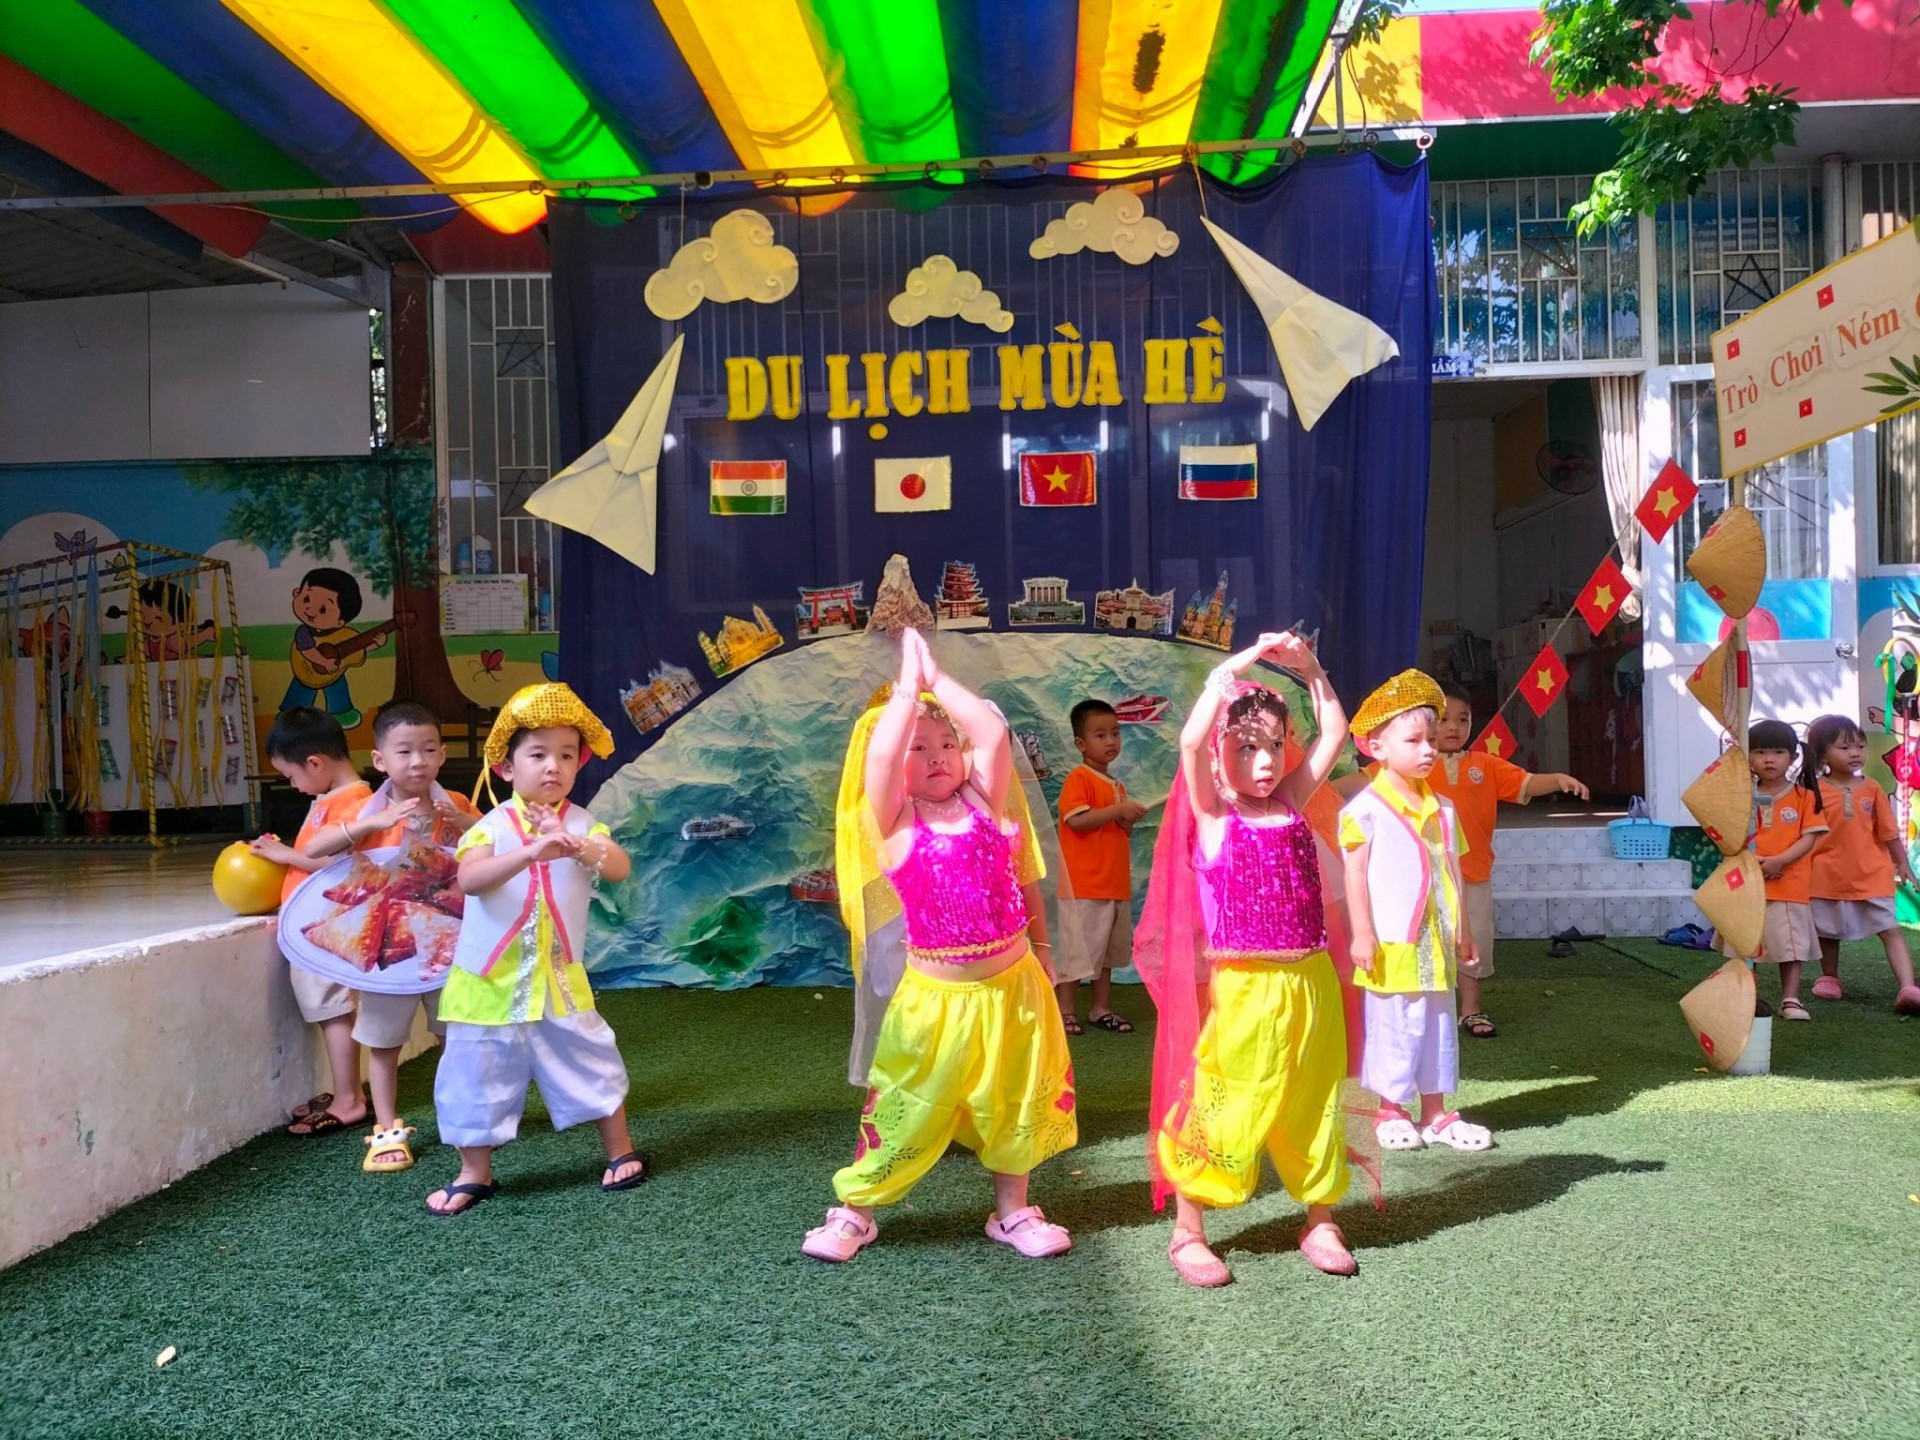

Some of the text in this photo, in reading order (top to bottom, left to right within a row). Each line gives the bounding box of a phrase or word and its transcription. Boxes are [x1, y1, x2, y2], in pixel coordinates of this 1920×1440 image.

[725, 316, 1227, 441] DU LỊCH MÙA HÈ
[1722, 307, 1900, 415] Trò Chơi Ném
